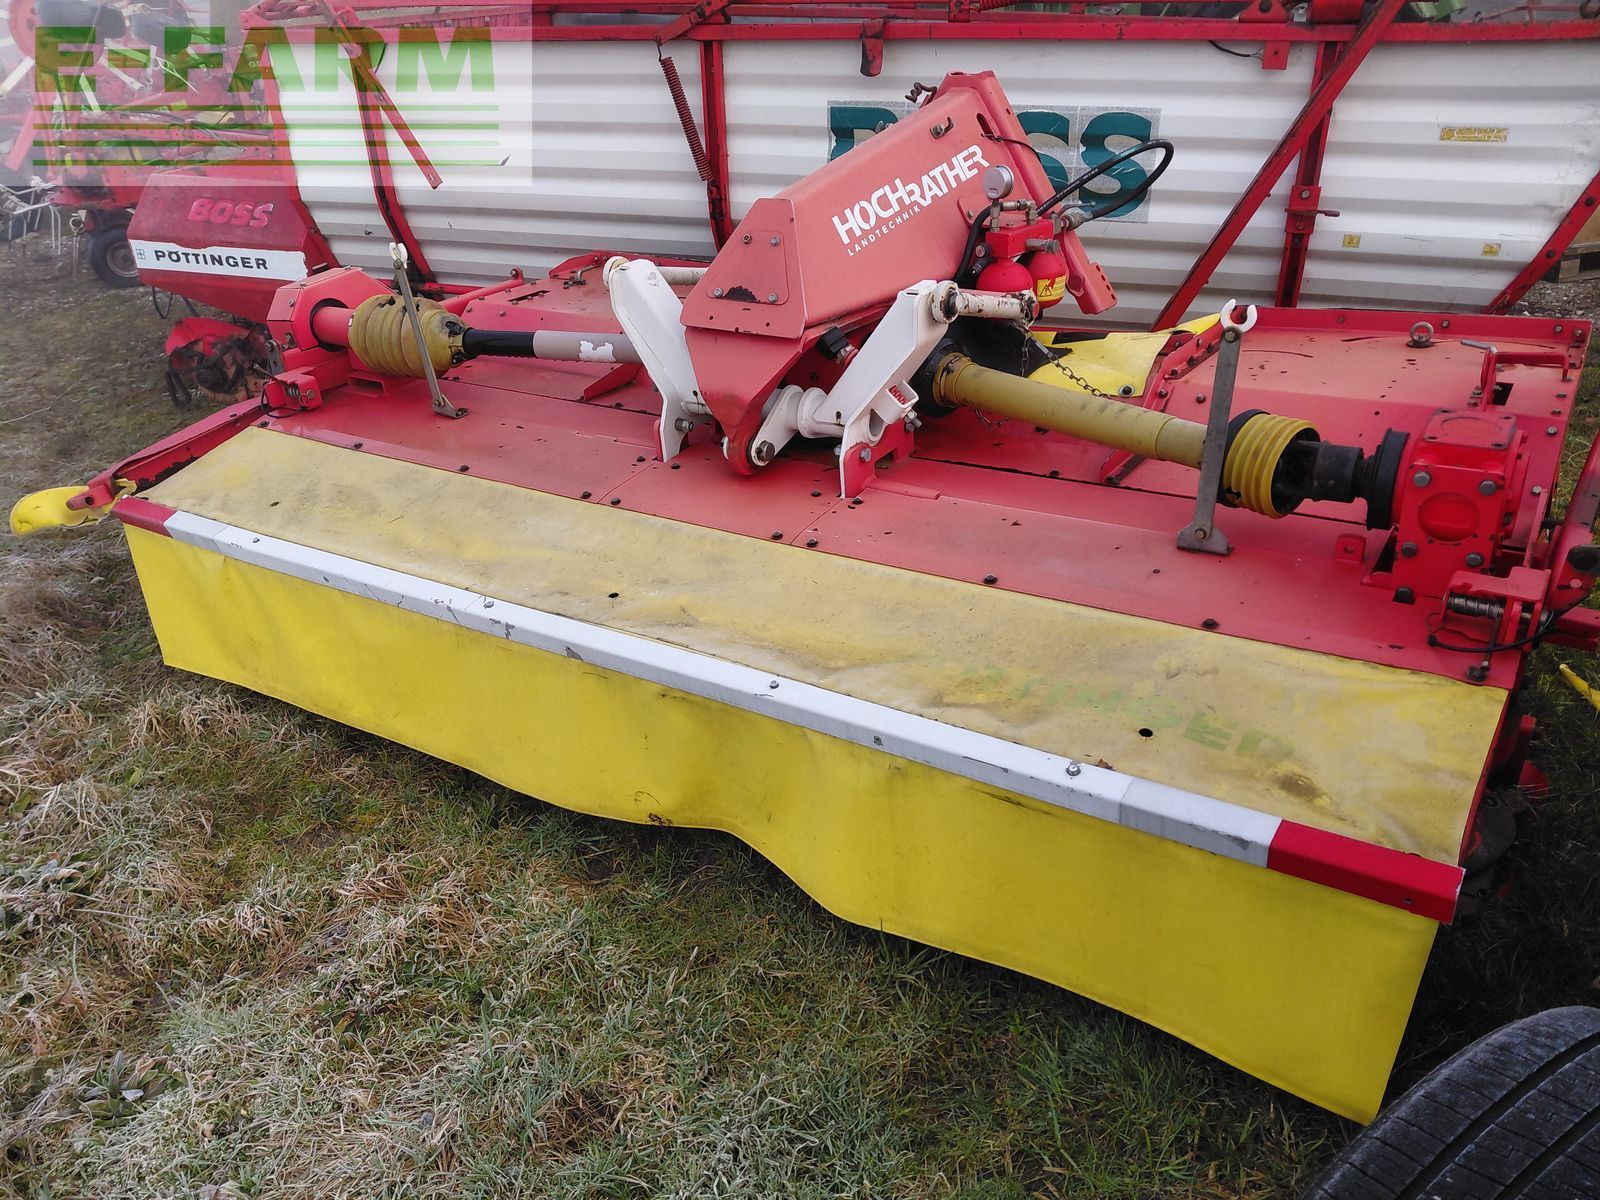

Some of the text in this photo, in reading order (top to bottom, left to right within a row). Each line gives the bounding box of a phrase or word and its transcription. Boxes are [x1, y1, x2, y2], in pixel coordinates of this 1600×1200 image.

[187, 199, 274, 228] BOSS
[847, 204, 922, 257] LANDTECHNIK
[154, 249, 269, 270] PÖTTINGER
